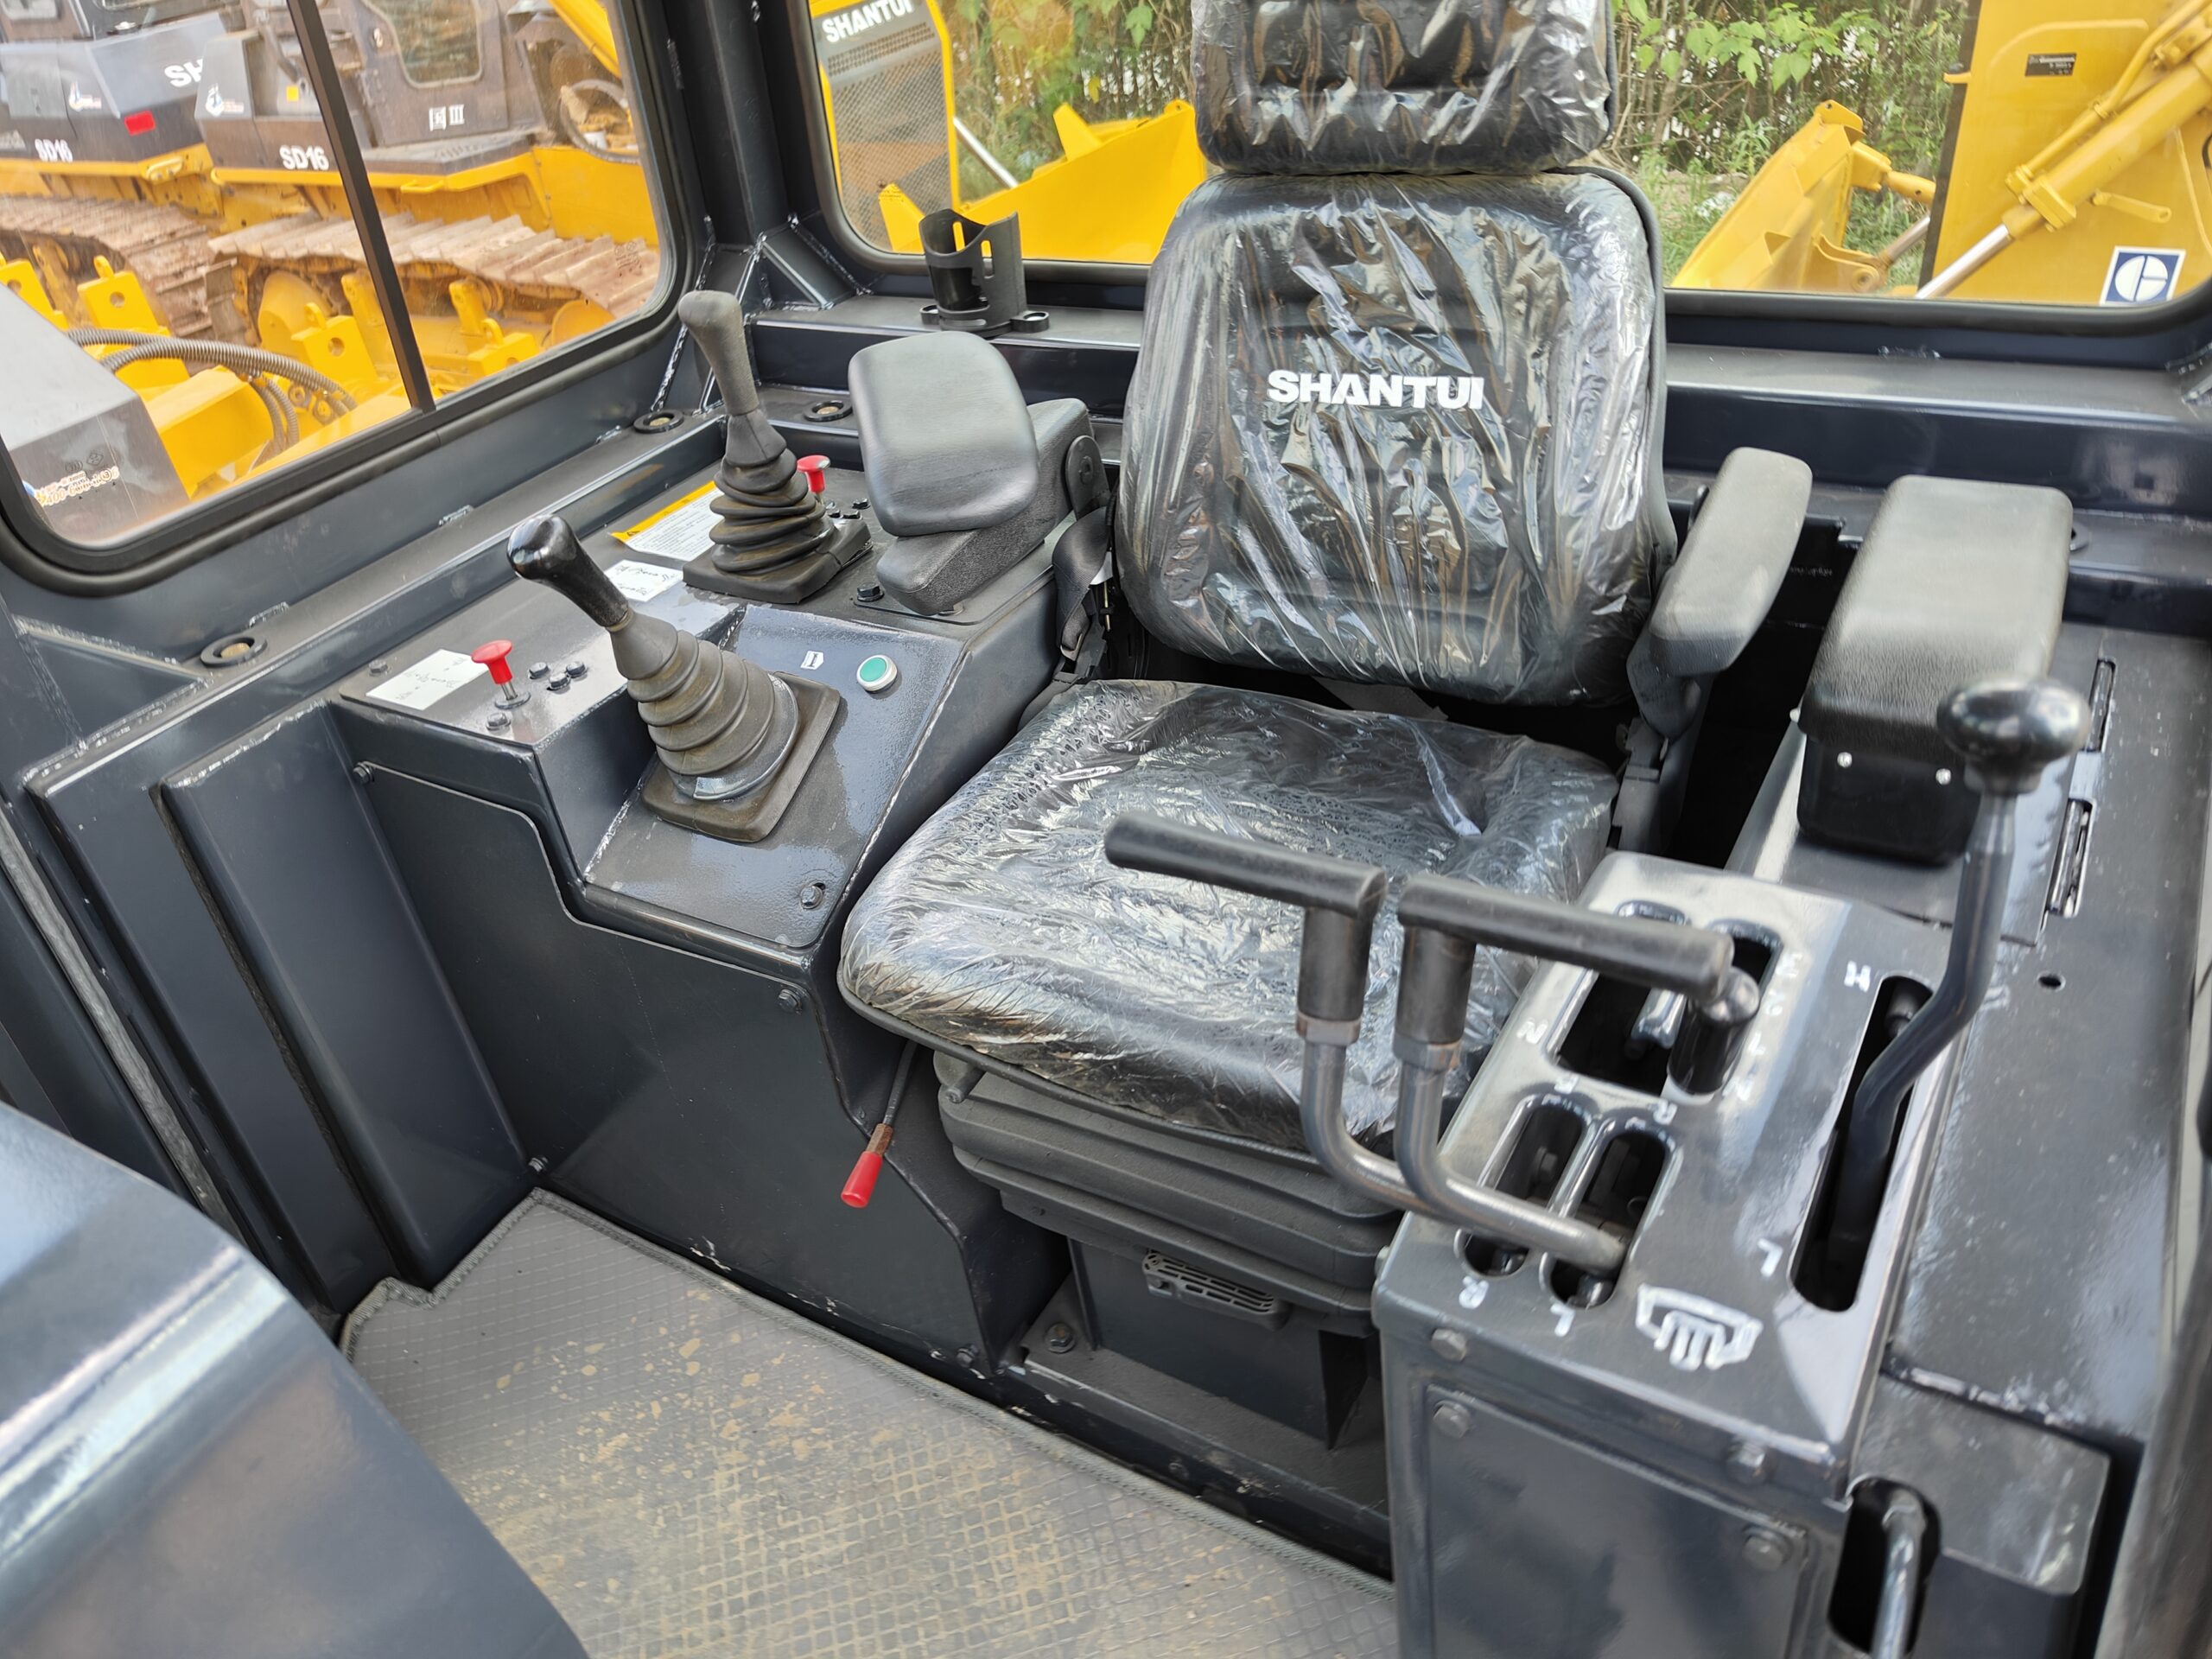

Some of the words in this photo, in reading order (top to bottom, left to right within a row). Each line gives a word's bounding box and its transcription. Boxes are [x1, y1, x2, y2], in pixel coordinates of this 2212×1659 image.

[823, 0, 912, 42] SHANTUI
[35, 139, 73, 162] SD16
[279, 145, 329, 170] SD16
[1268, 370, 1484, 410] SHANTUI
[1843, 961, 1871, 992] H
